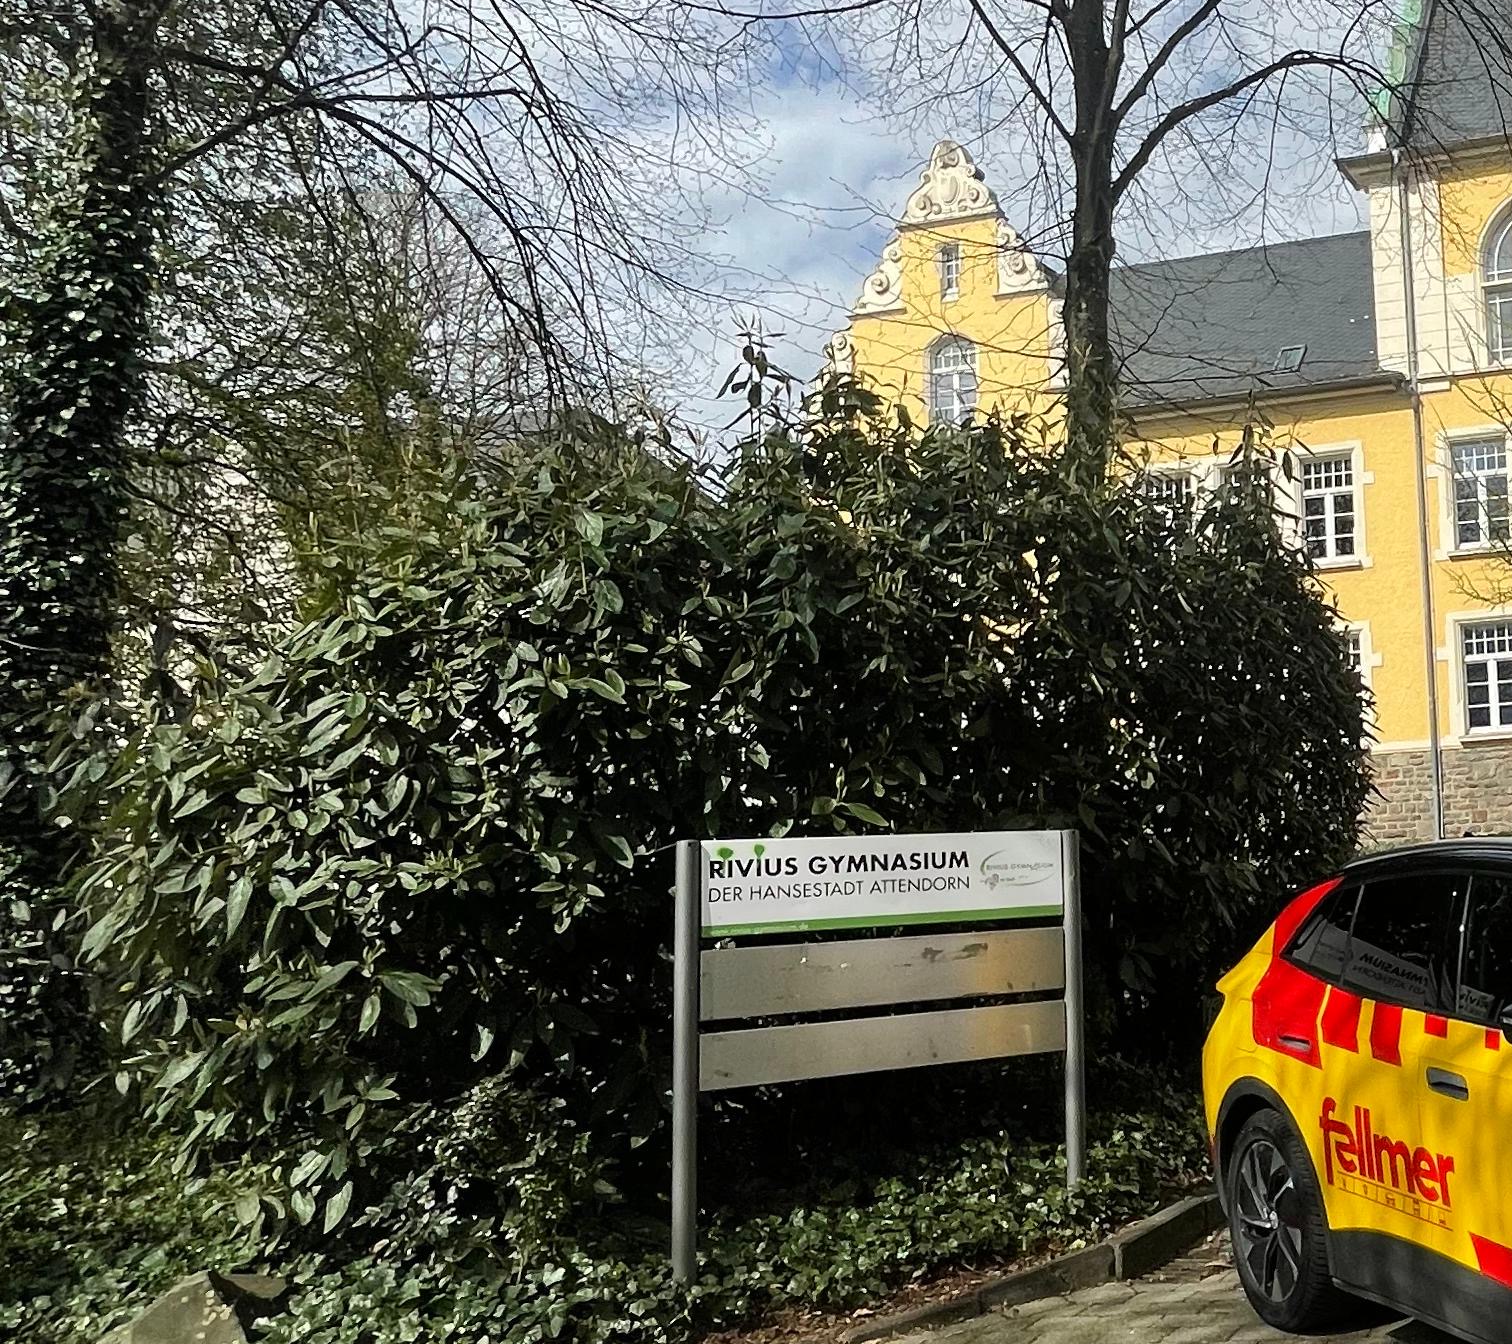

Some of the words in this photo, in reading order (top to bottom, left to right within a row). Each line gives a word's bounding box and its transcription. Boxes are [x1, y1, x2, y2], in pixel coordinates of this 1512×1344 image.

[709, 857, 798, 879] RIVIUS
[808, 851, 969, 875] GYMNASIUM
[708, 886, 743, 903] DER
[750, 880, 864, 901] HANSESTADT
[869, 876, 970, 894] ATTENDORN
[1319, 1097, 1455, 1208] fellmer
